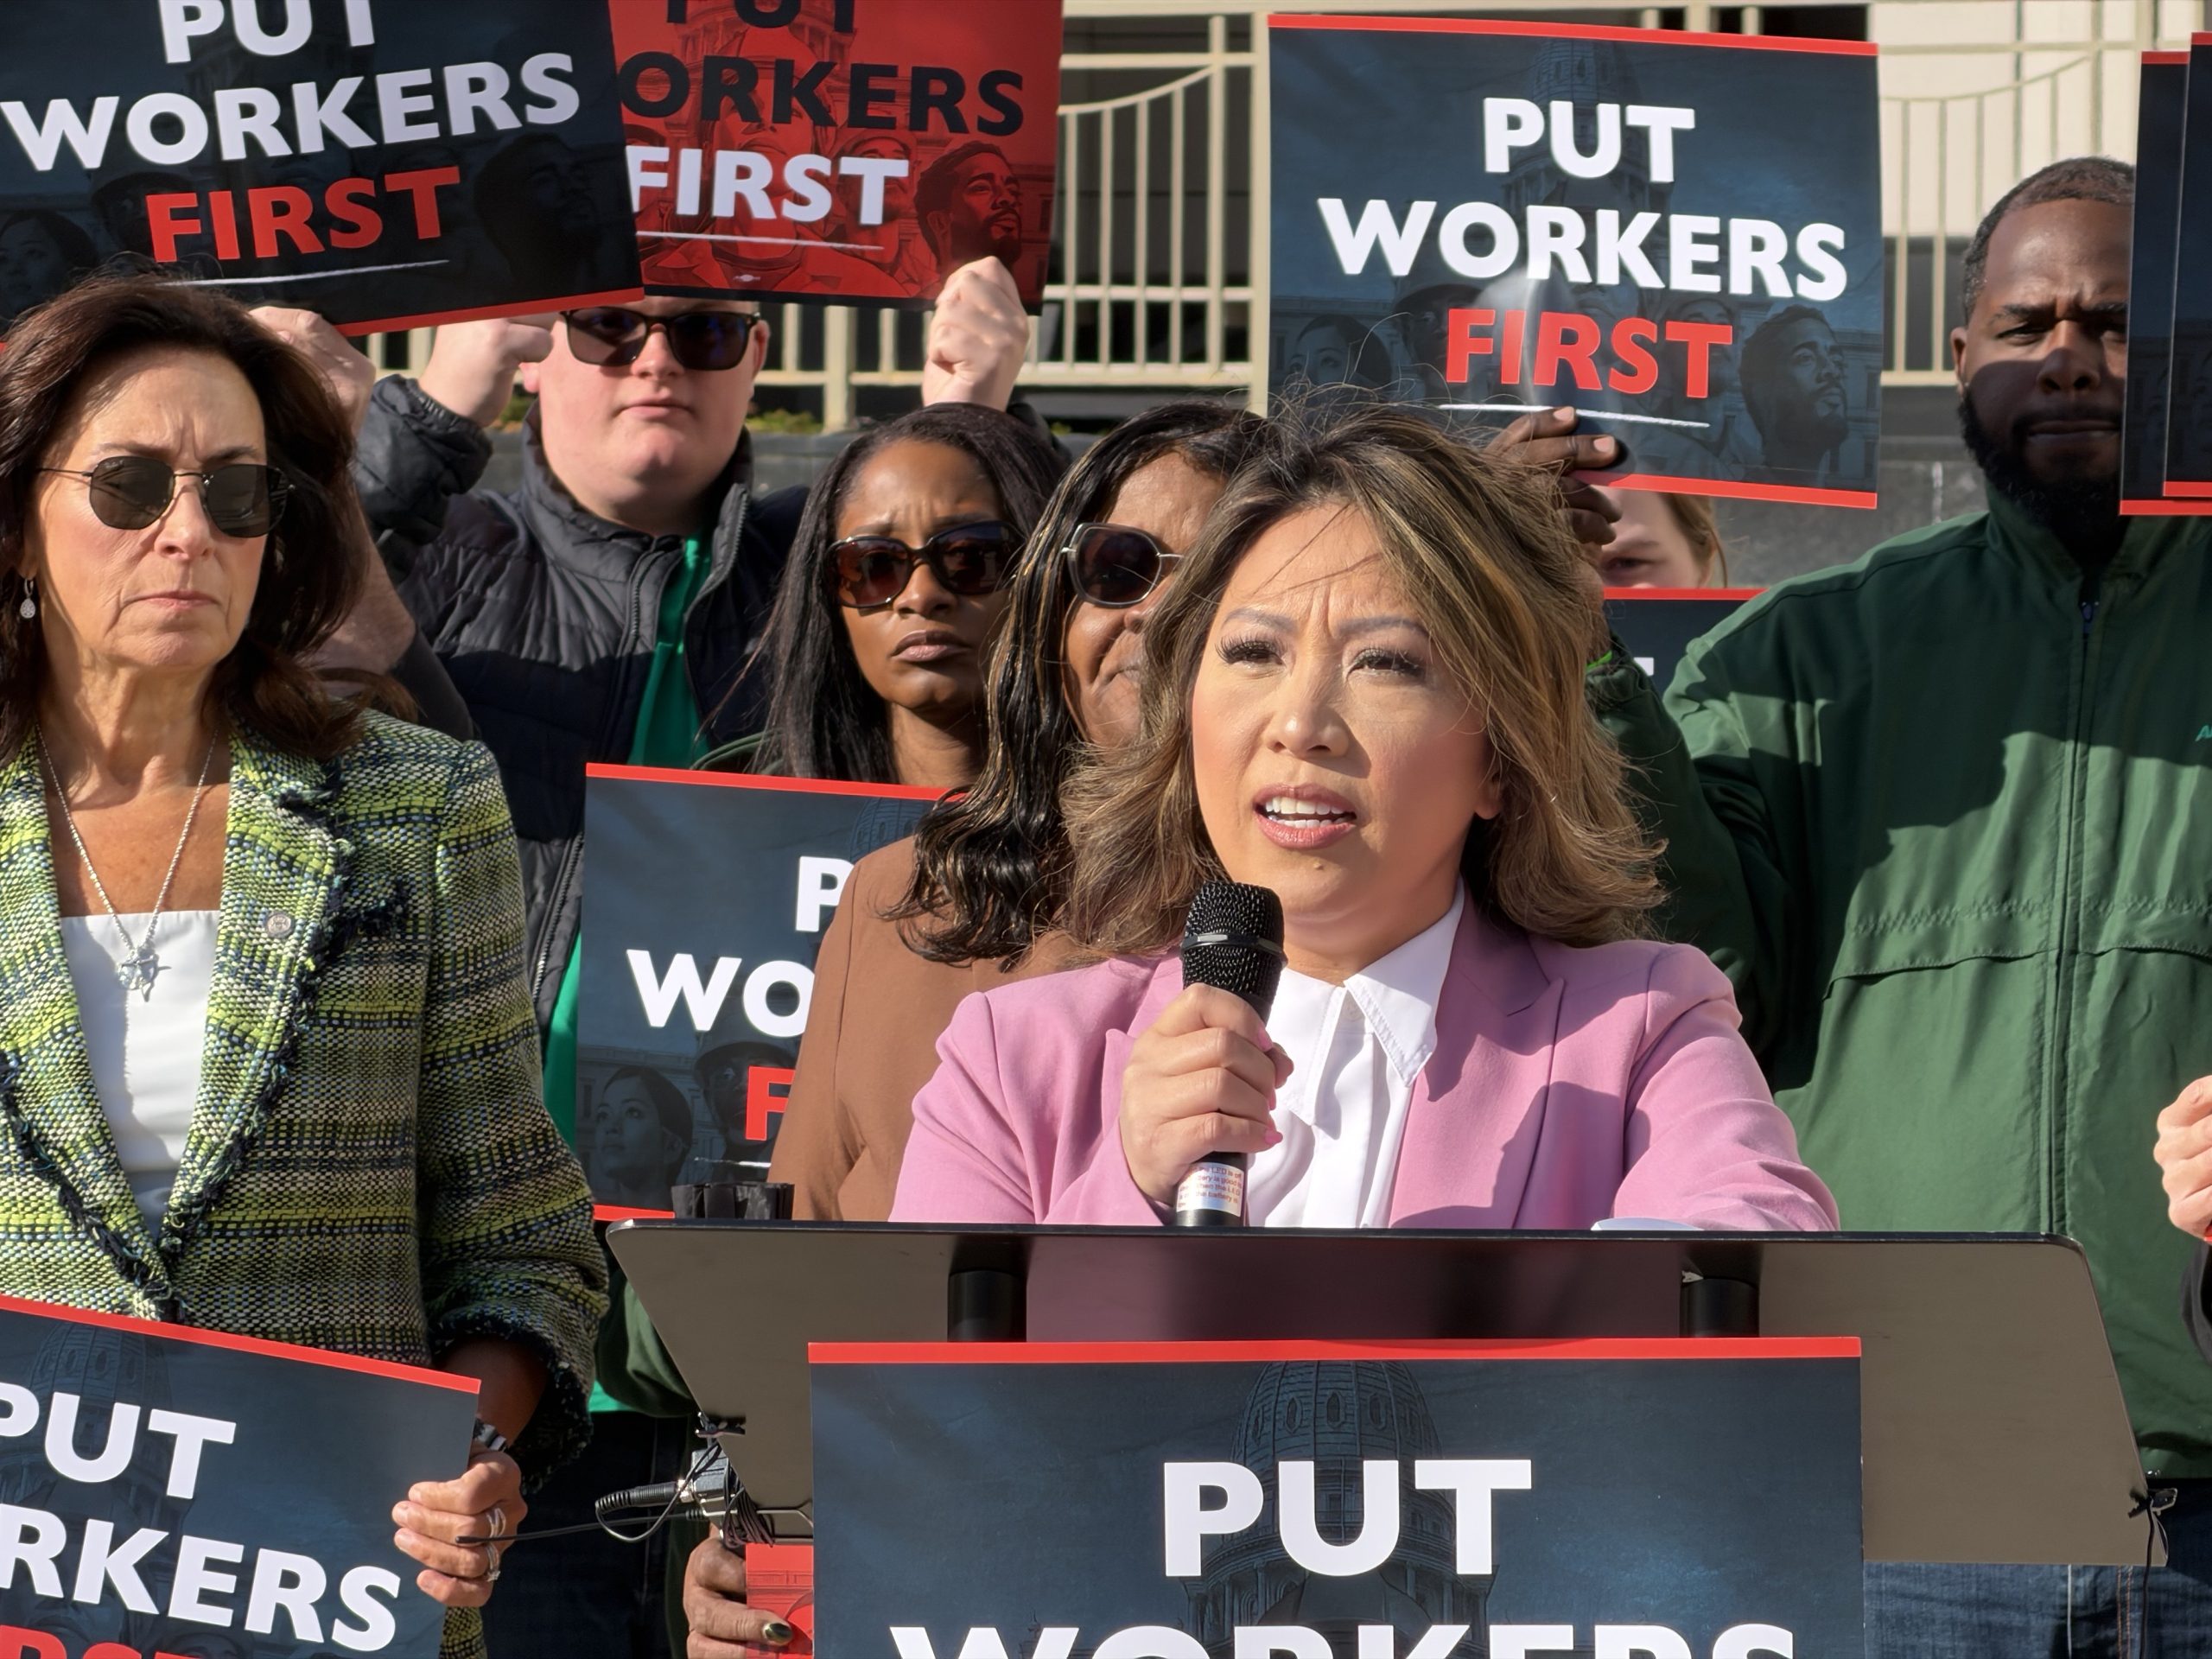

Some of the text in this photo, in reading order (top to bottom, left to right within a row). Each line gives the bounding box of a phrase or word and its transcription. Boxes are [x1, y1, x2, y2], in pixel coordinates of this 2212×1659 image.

[0, 54, 579, 170] WORKERS
[618, 52, 1023, 136] ORKERS
[1484, 98, 1695, 182] PUT
[146, 166, 461, 263] FIRST
[626, 145, 908, 225] FIRST
[1318, 198, 1847, 301] WORKERS
[1446, 308, 1732, 398] FIRST
[1164, 1459, 1532, 1576] PUT
[0, 1503, 401, 1651] RKERS
